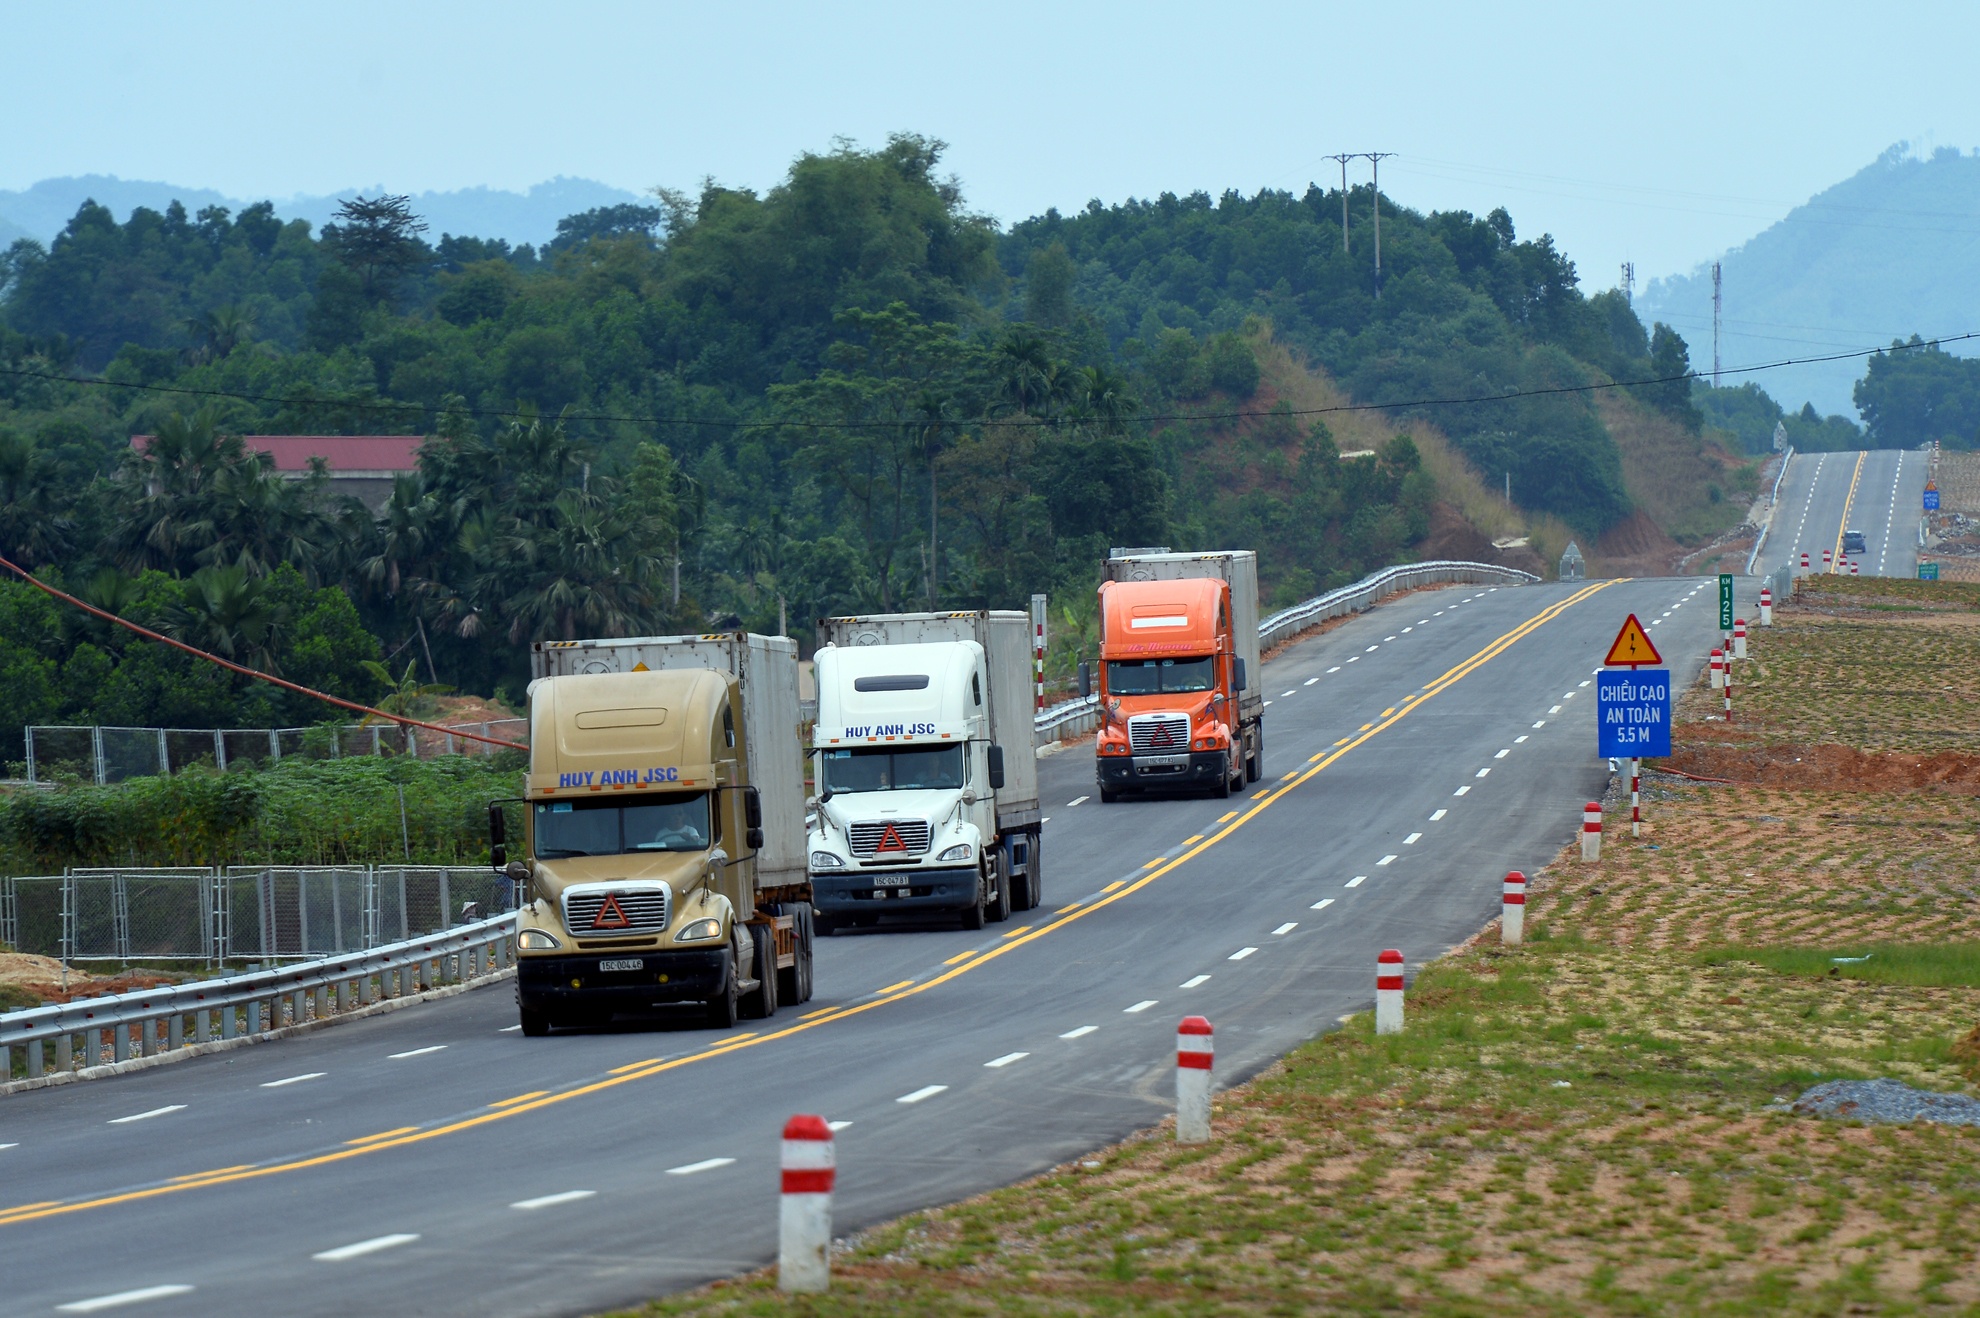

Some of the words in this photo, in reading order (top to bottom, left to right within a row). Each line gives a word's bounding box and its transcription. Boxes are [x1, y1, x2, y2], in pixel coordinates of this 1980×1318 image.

[1721, 577, 1731, 585] KM
[1600, 680, 1637, 702] CHIỀU
[1640, 685, 1666, 701] CAO
[1606, 707, 1624, 724] AN
[1626, 703, 1661, 723] TOÀN
[845, 726, 872, 738] HUY
[875, 723, 904, 736] ANH
[908, 722, 936, 735] JSC
[1617, 727, 1636, 743] 5.5
[1638, 726, 1650, 743] M
[559, 771, 595, 788] HUY
[600, 768, 639, 785] ANH
[642, 766, 679, 783] JSC
